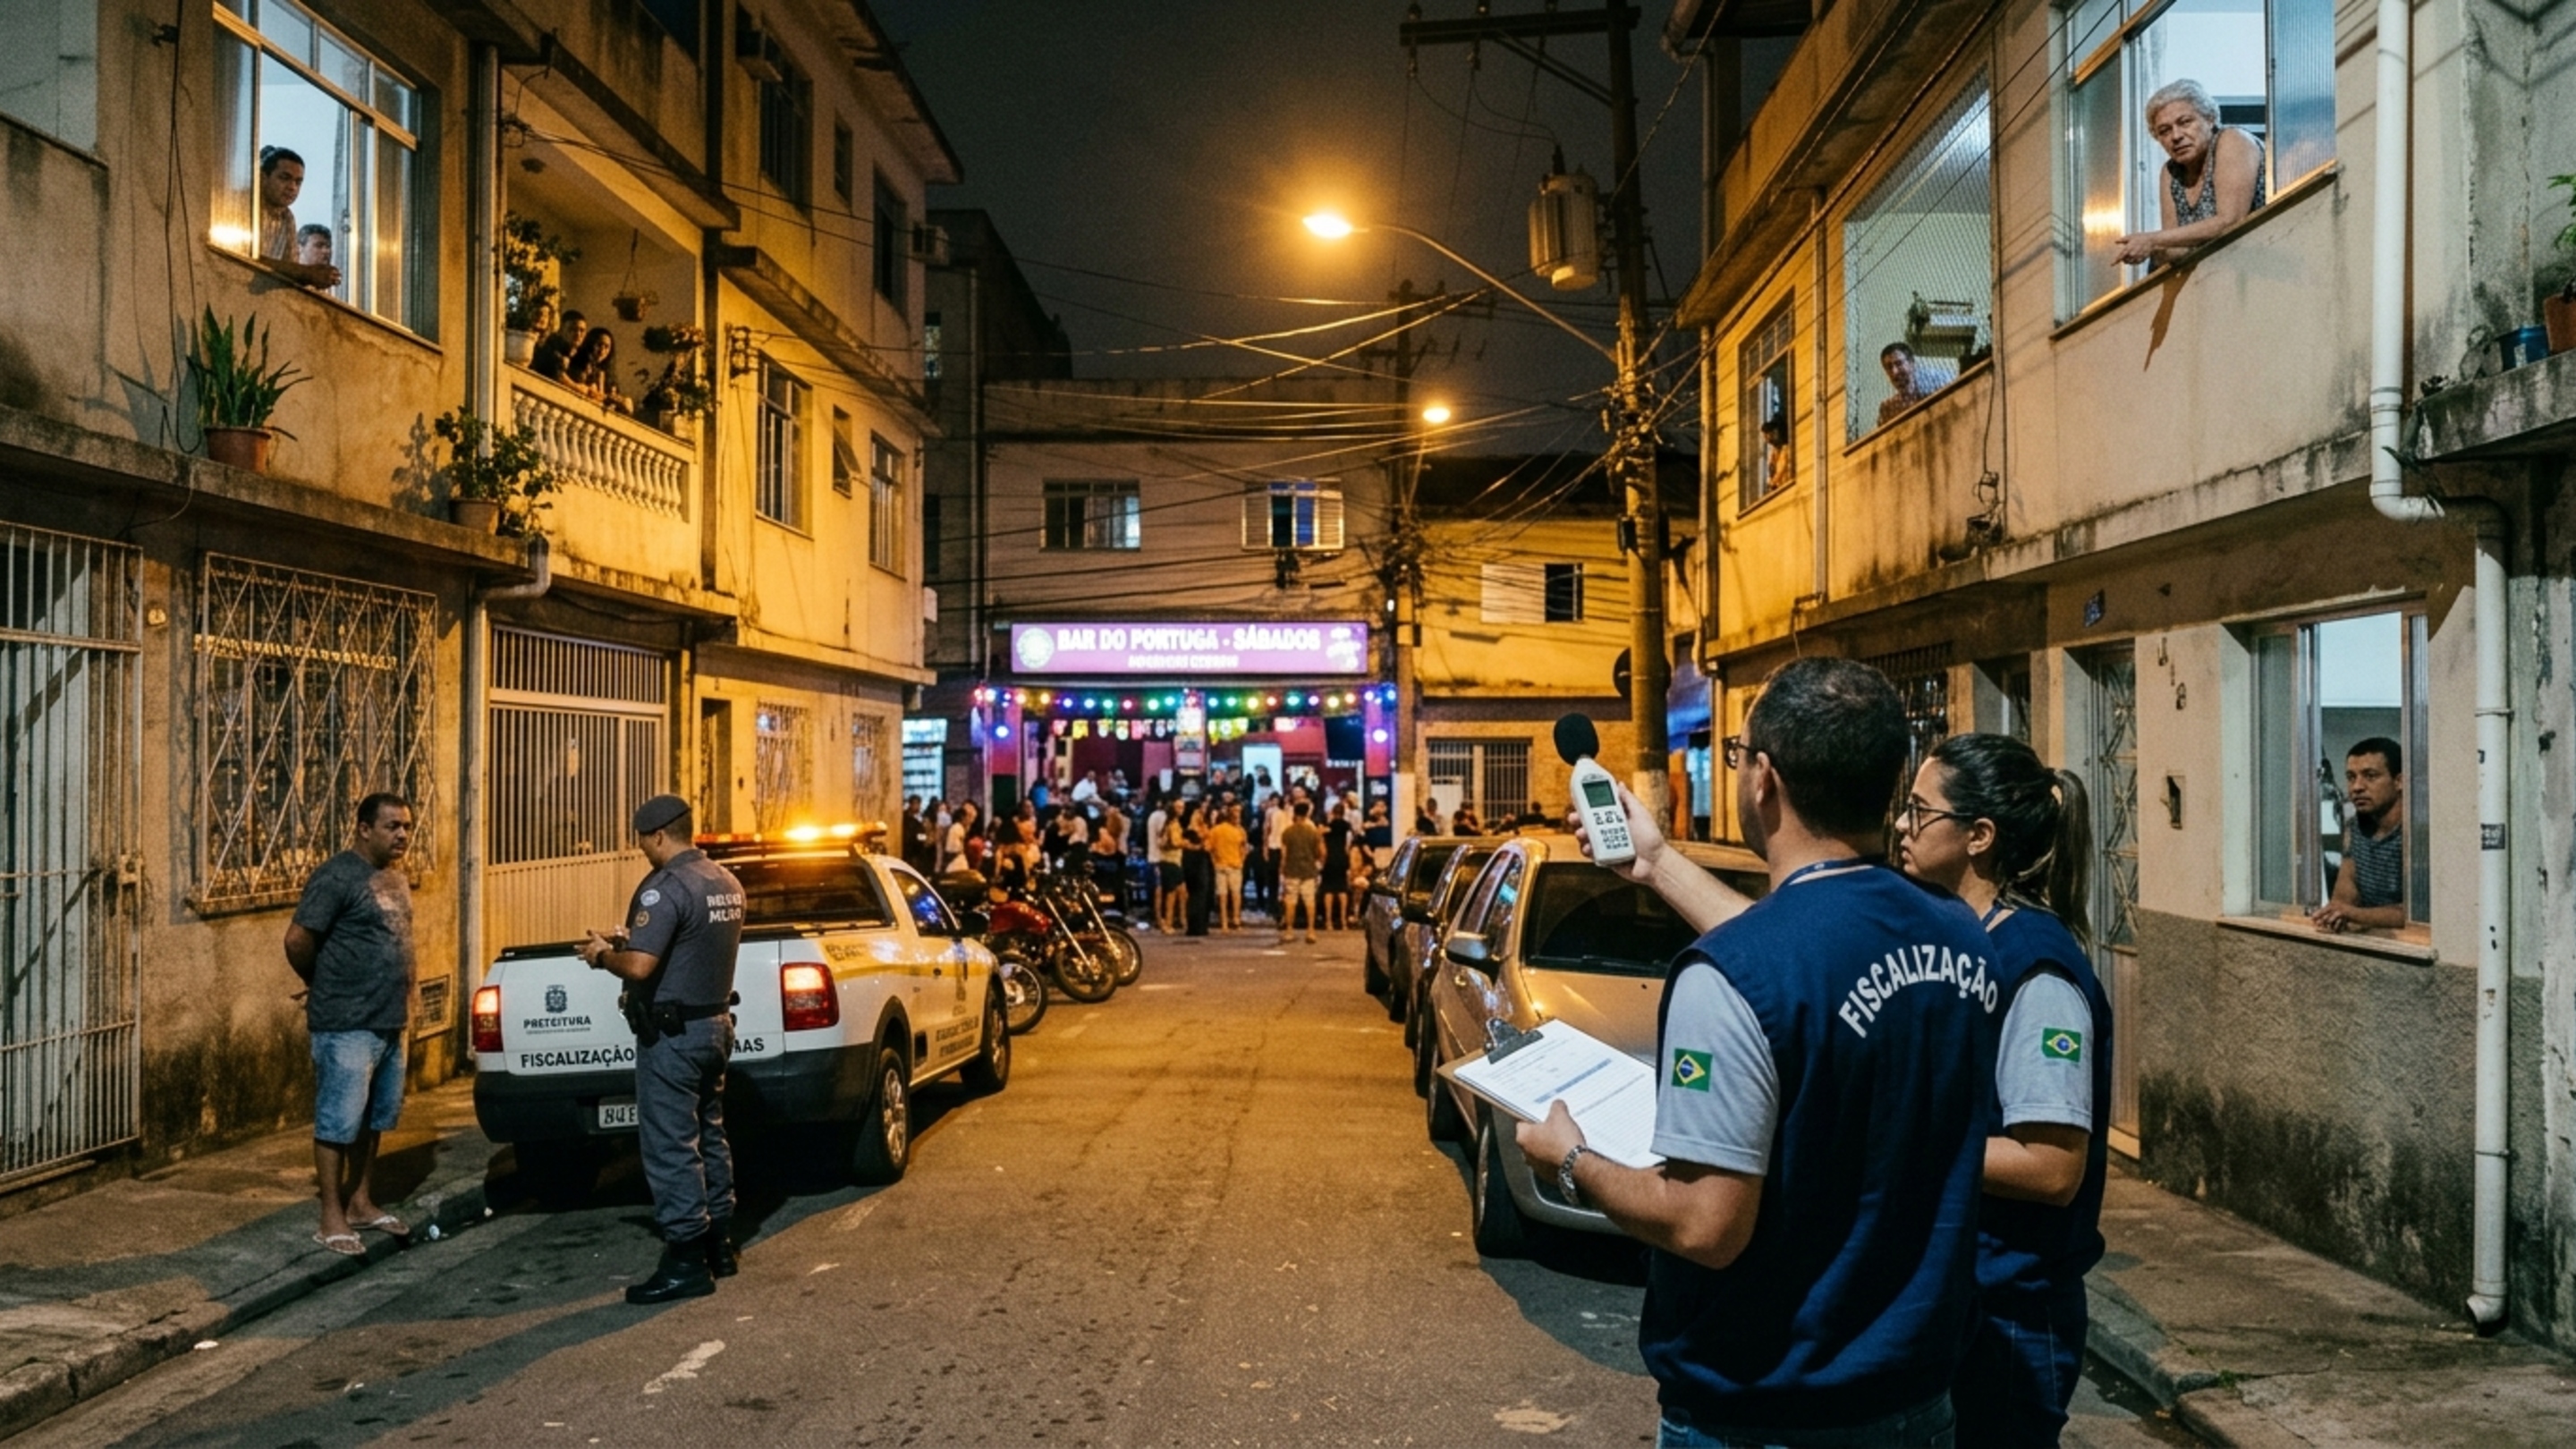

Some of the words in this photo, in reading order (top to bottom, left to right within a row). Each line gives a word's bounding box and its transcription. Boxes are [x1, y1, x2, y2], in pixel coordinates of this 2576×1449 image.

[1057, 629, 1097, 651] BAR
[1099, 628, 1127, 651] DO
[1233, 624, 1321, 650] SÁBADOS
[1838, 945, 1998, 1038] FISCALIZAÇÃO
[521, 1045, 635, 1068] FISCALIZAÇÃO
